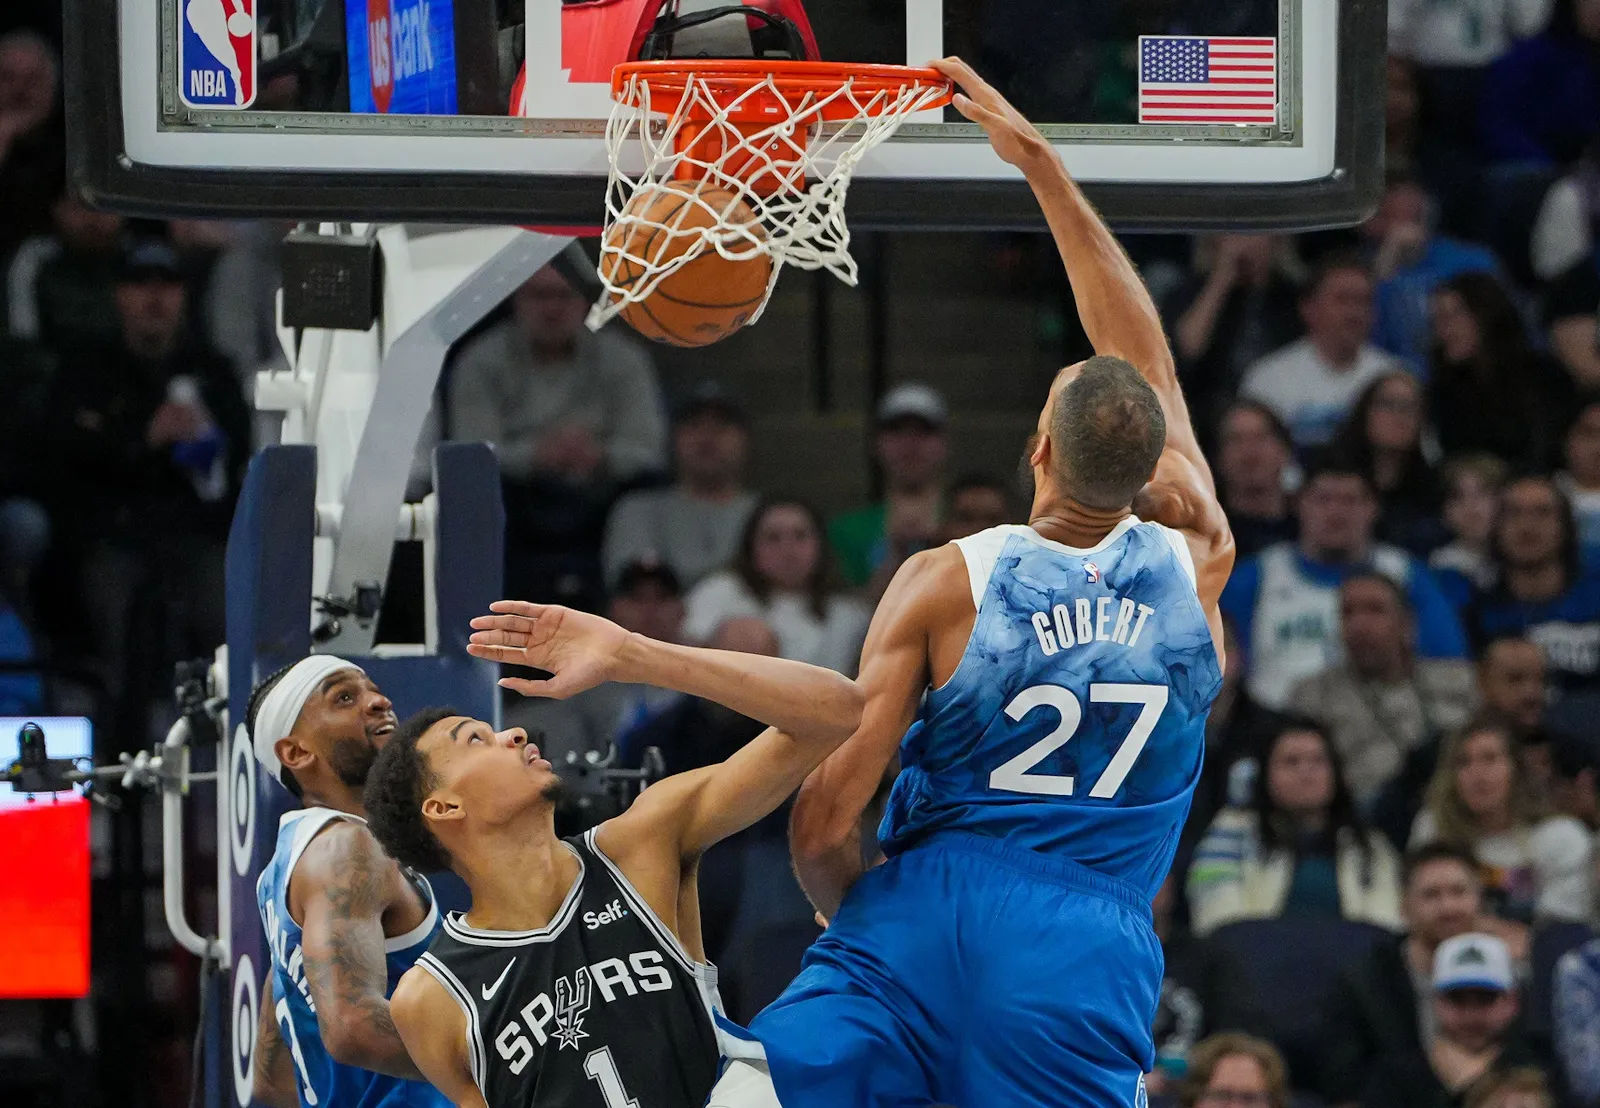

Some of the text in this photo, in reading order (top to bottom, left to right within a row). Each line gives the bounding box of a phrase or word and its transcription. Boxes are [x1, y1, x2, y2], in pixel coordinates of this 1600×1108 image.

[371, 0, 434, 89] us bank
[190, 69, 227, 98] NBA
[1031, 596, 1155, 656] GOBERT
[988, 683, 1169, 799] 27
[495, 950, 673, 1076] SPURS
[583, 1045, 643, 1108] 1
